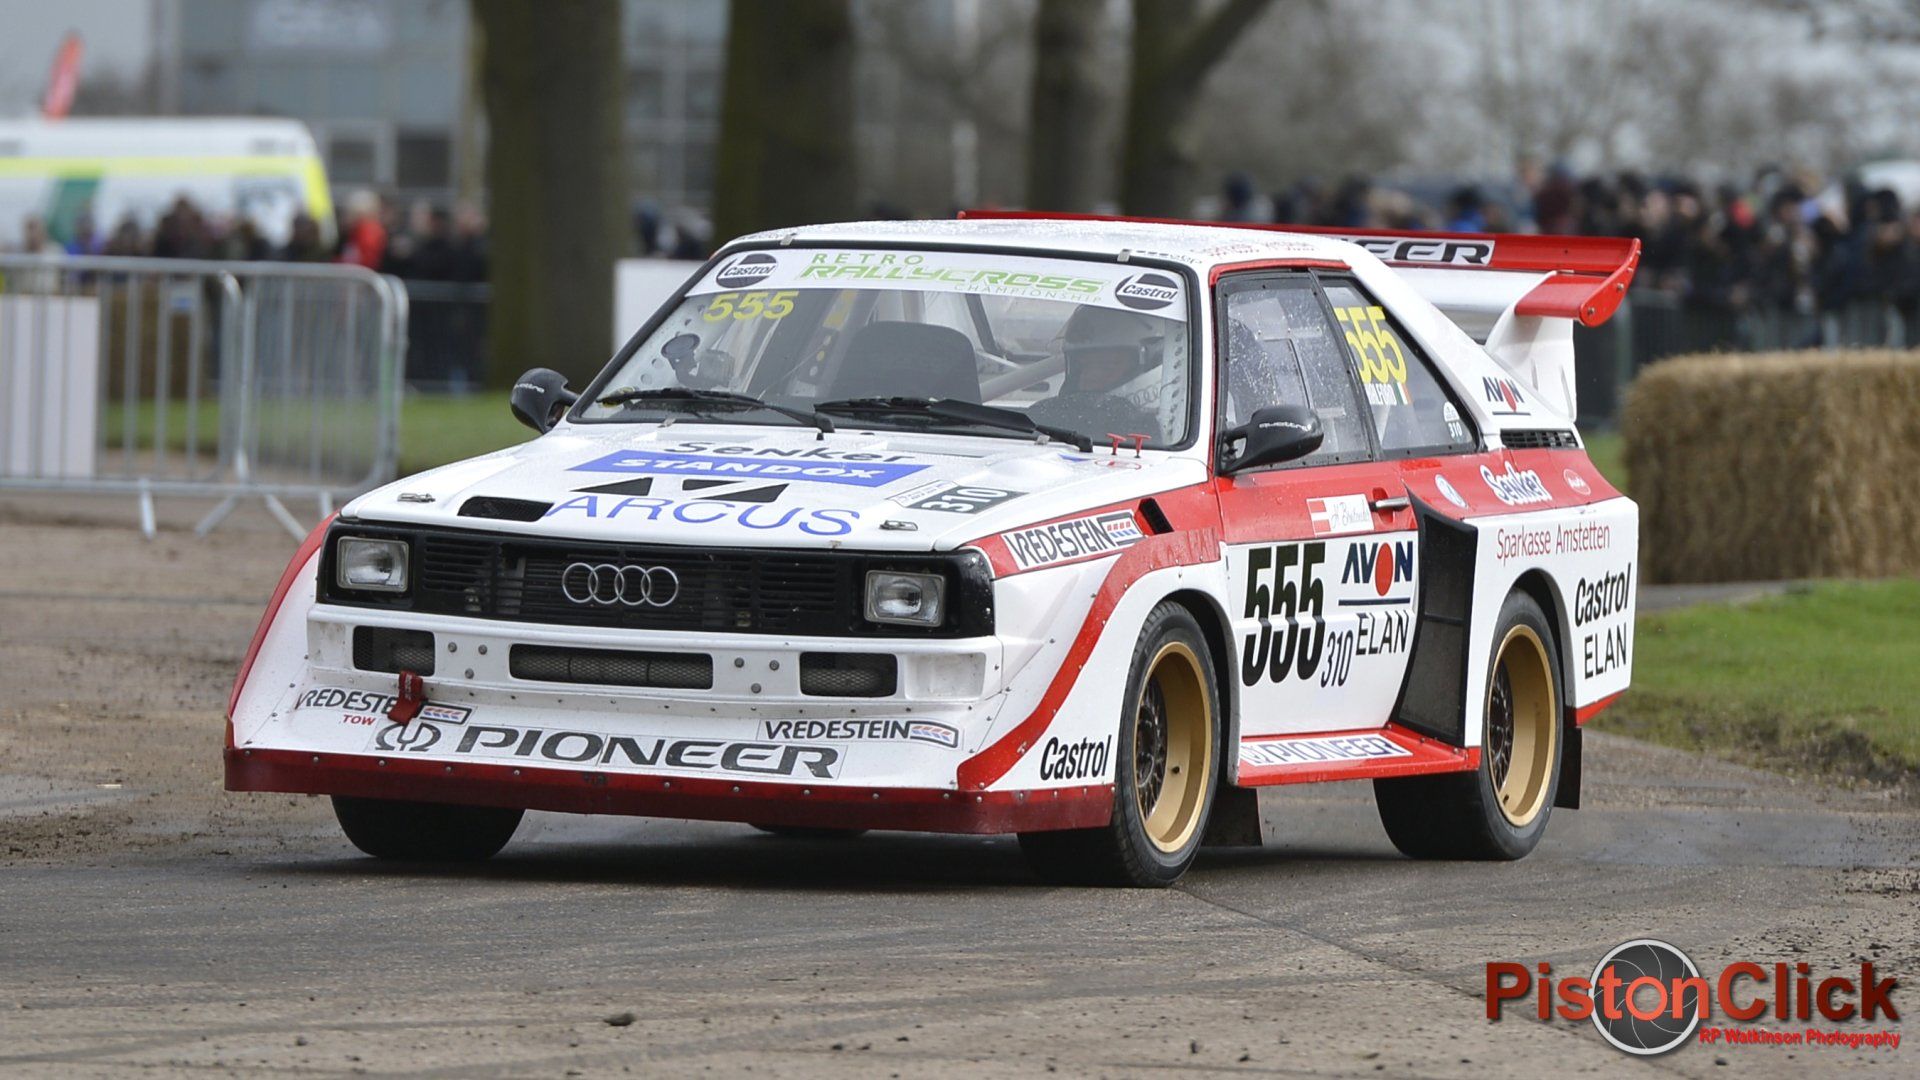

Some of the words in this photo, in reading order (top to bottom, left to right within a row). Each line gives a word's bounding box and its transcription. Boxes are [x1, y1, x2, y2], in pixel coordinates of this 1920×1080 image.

[812, 253, 924, 265] RETRO
[1341, 239, 1490, 264] EER
[724, 264, 776, 277] Castrol
[798, 265, 1105, 293] RALLYCROSS
[704, 291, 799, 321] 555
[954, 284, 1102, 302] CHAMPIONSHIP
[1122, 283, 1178, 300] Castrol
[1333, 306, 1407, 383] 555
[1482, 376, 1525, 412] AVON
[1448, 421, 1463, 438] 310
[664, 442, 916, 463] Senker
[613, 458, 887, 479] STANDOX
[920, 488, 1008, 511] 310
[545, 495, 860, 536] ARCUS
[1004, 516, 1117, 567] VREDESTEIN
[1496, 527, 1551, 566] Sparkasse
[1556, 524, 1611, 554] Amstetten
[1341, 541, 1414, 597] AVON
[1575, 563, 1631, 627] Castrol
[1242, 542, 1326, 687] 555
[1356, 610, 1410, 656] ELAN
[1321, 629, 1354, 688] 310
[1584, 622, 1628, 680] ELAN
[295, 688, 399, 715] VREDESTE
[343, 714, 376, 726] TOW
[764, 720, 911, 740] VREDESTEIN
[456, 726, 840, 778] PIONEER
[1039, 735, 1112, 780] Castrol
[1259, 736, 1408, 763] PIONEER
